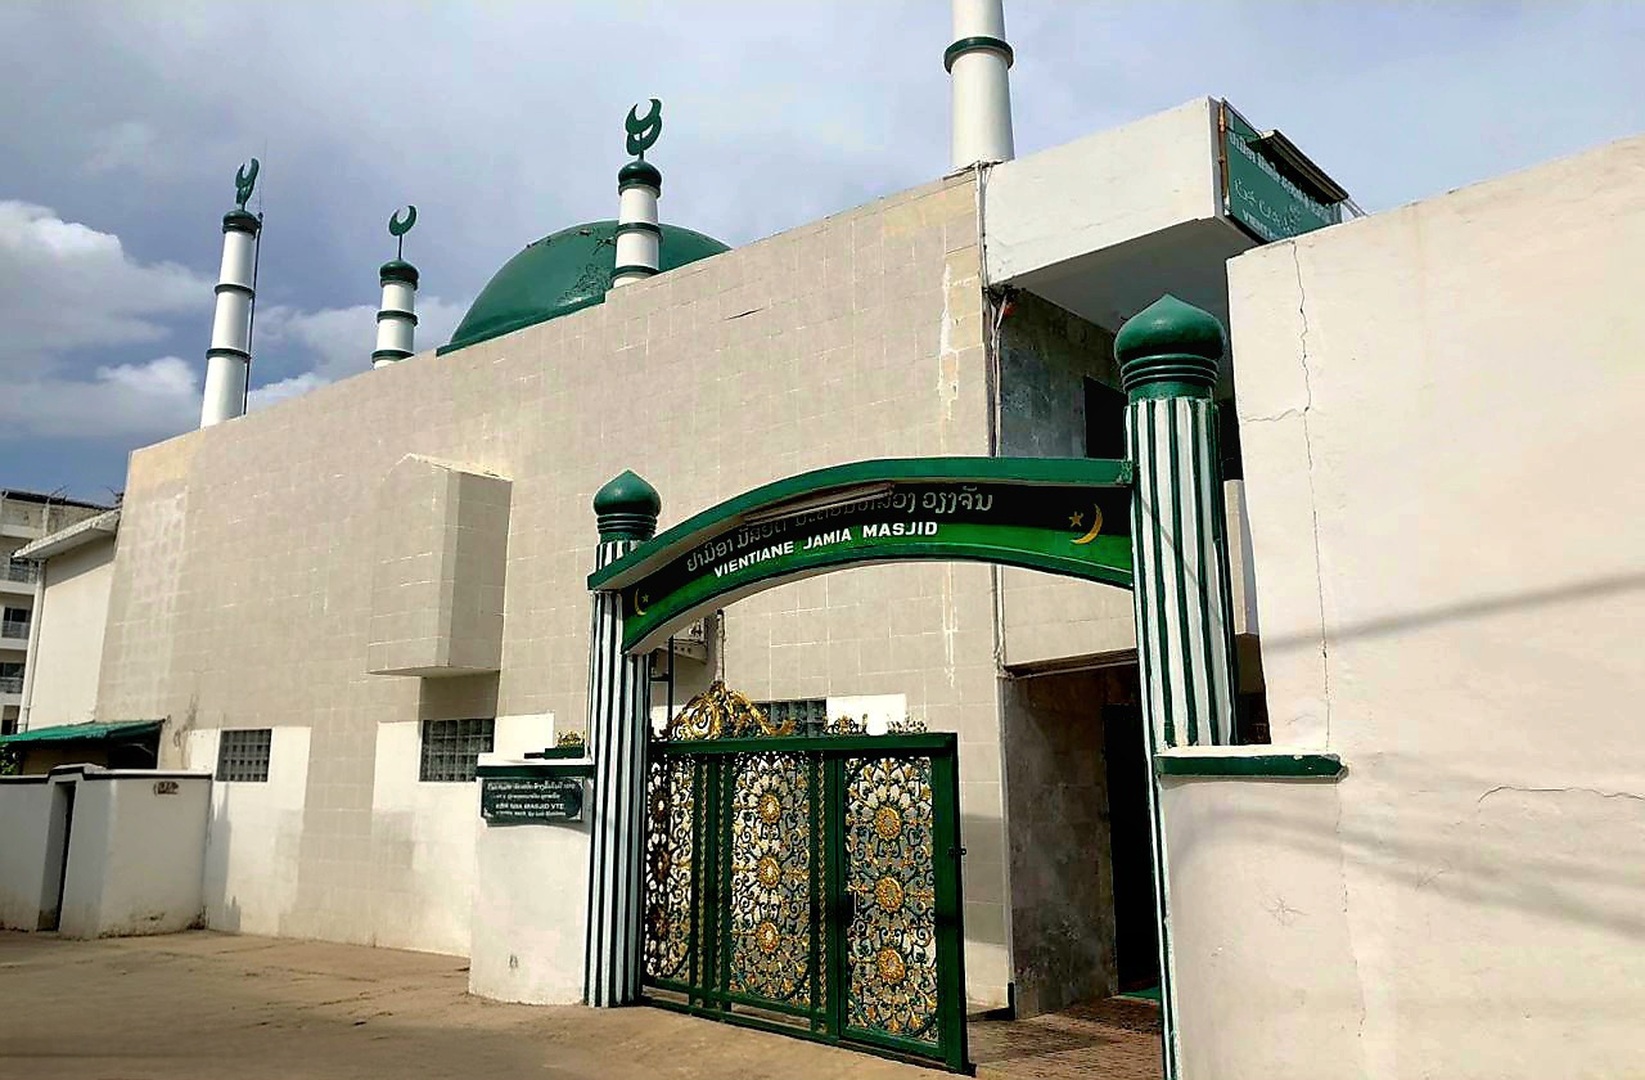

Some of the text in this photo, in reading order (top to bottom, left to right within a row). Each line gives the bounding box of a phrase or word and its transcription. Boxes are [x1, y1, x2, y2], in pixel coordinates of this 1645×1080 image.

[922, 485, 994, 514] ວຽງຈັນ
[713, 521, 938, 578] VIENTIANE JAMIA MASJID
